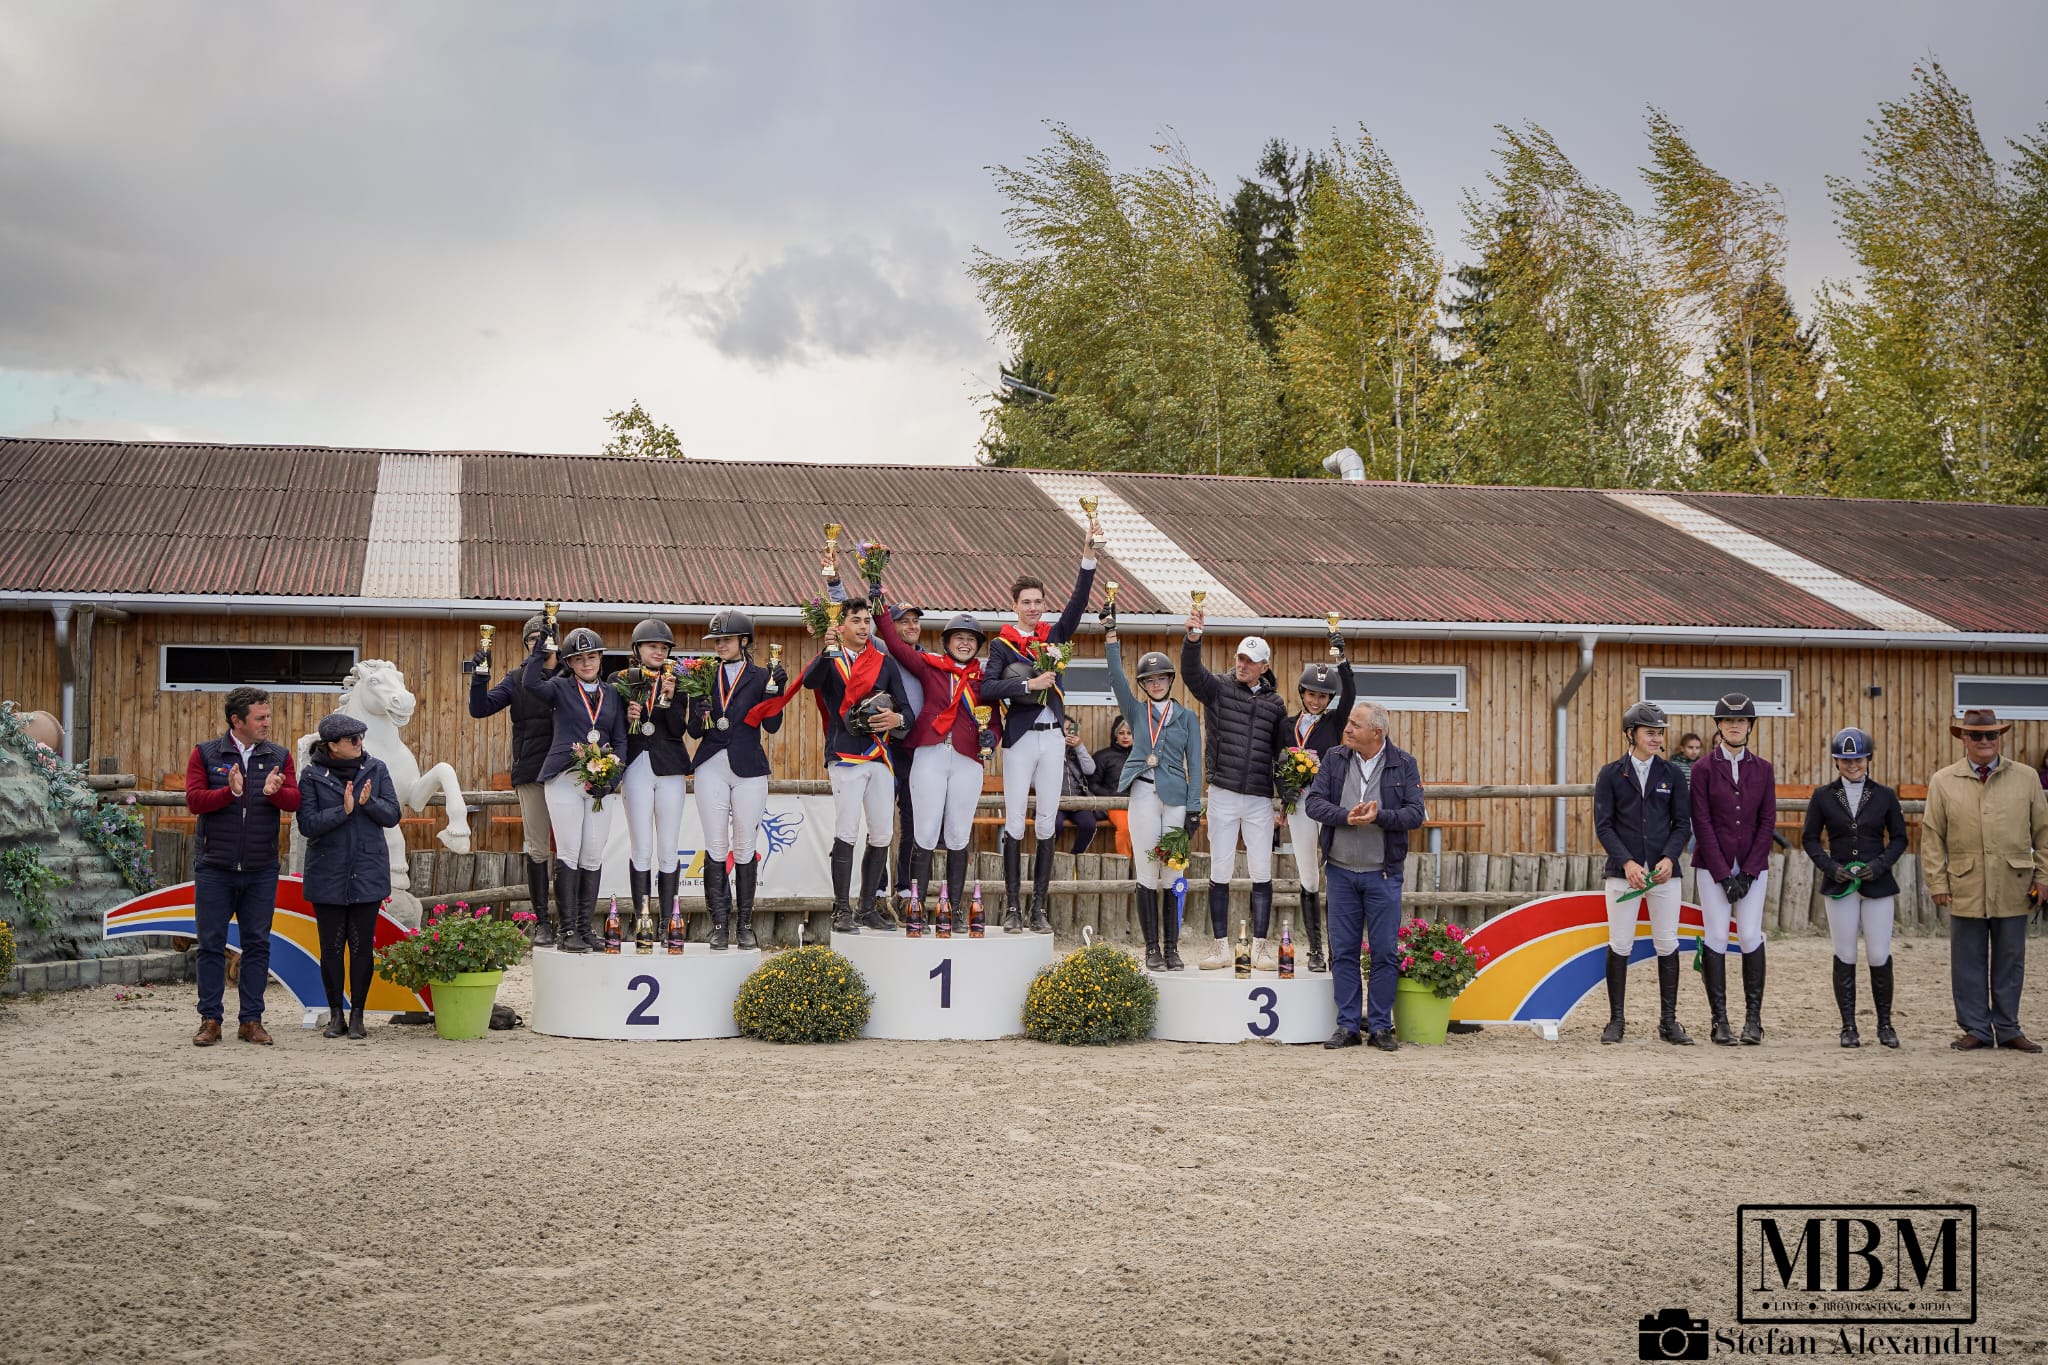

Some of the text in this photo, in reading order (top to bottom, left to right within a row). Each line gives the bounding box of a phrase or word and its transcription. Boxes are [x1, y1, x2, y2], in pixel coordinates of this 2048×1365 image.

[625, 974, 660, 1025] 2
[929, 958, 952, 1009] 1
[1247, 986, 1280, 1037] 3
